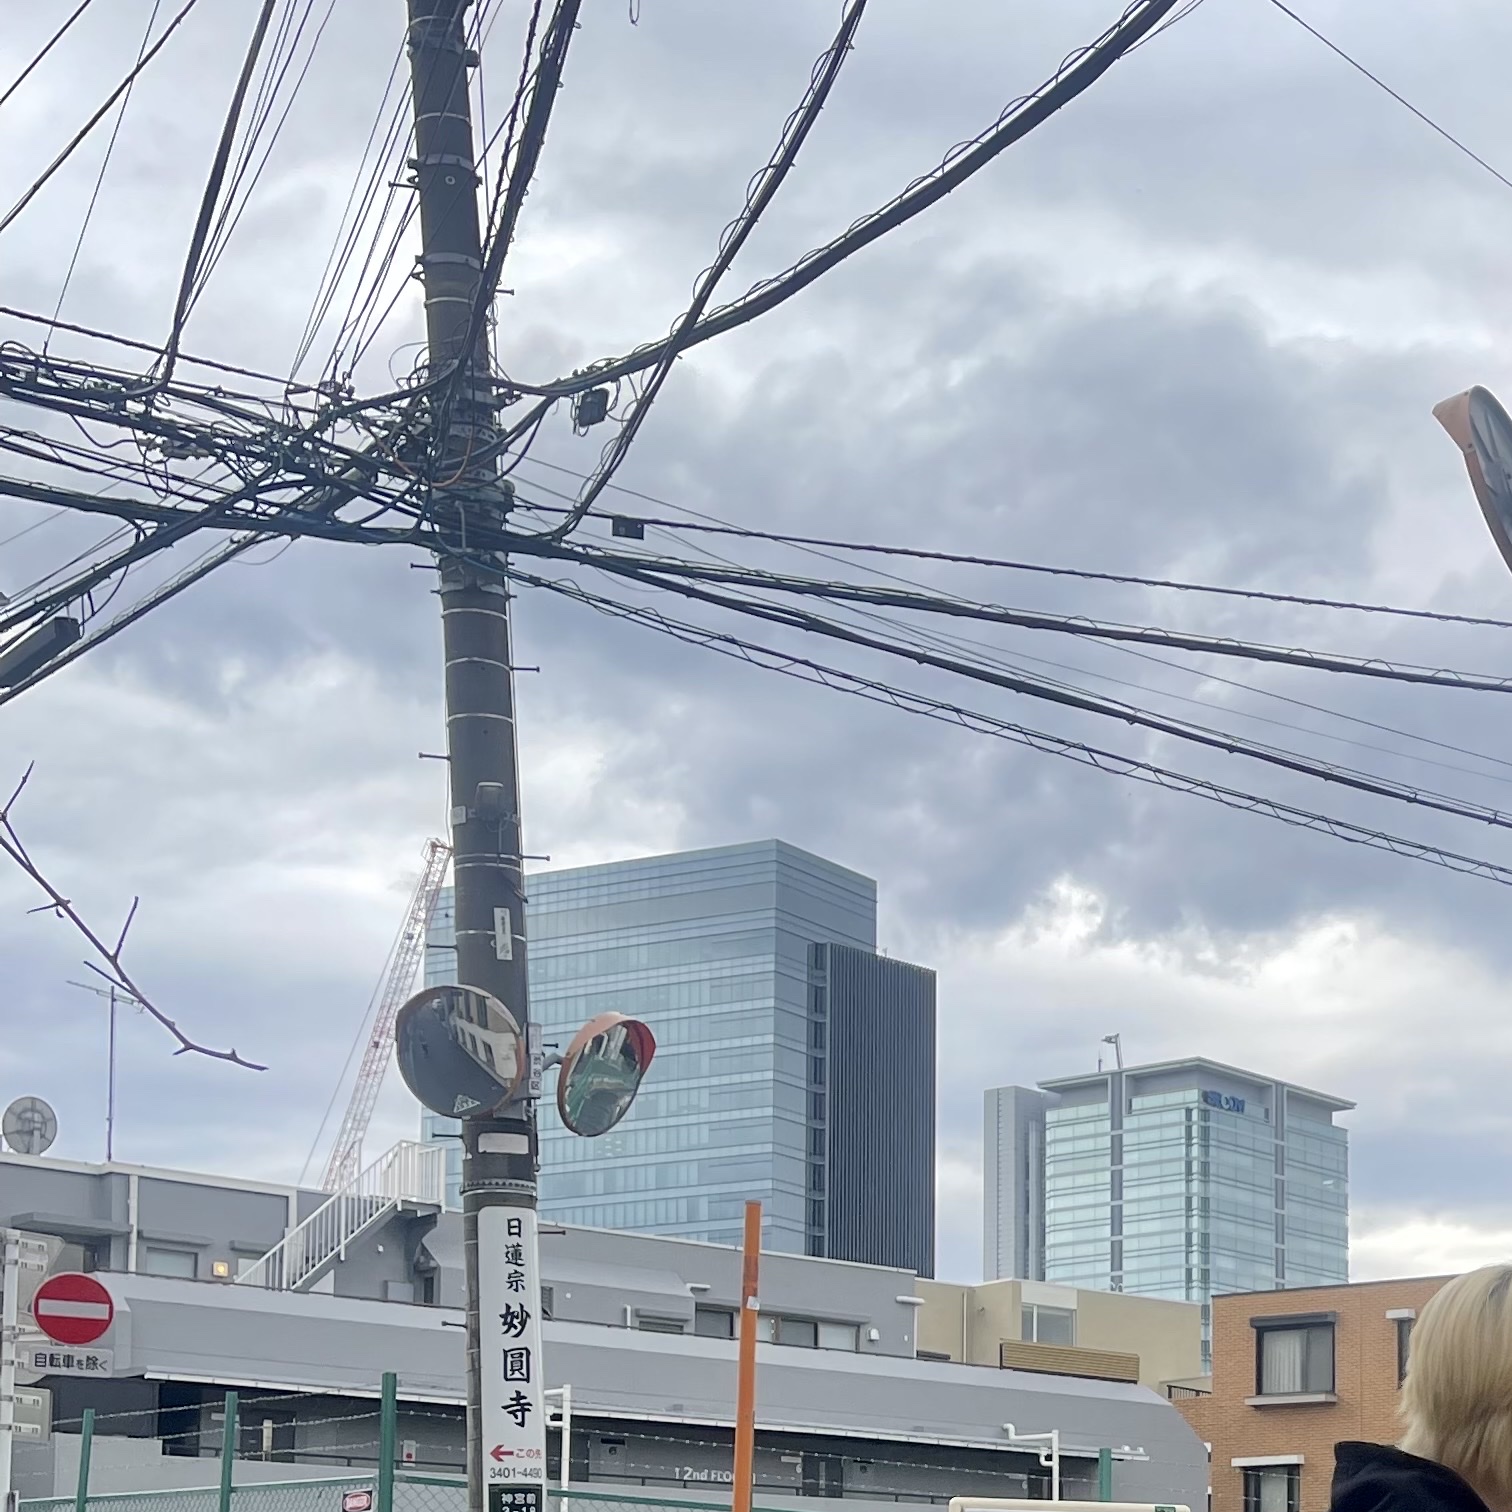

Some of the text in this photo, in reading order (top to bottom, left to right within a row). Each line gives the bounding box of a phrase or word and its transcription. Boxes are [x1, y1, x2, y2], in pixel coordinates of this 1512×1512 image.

[35, 1353, 108, 1371] 自転車を除く
